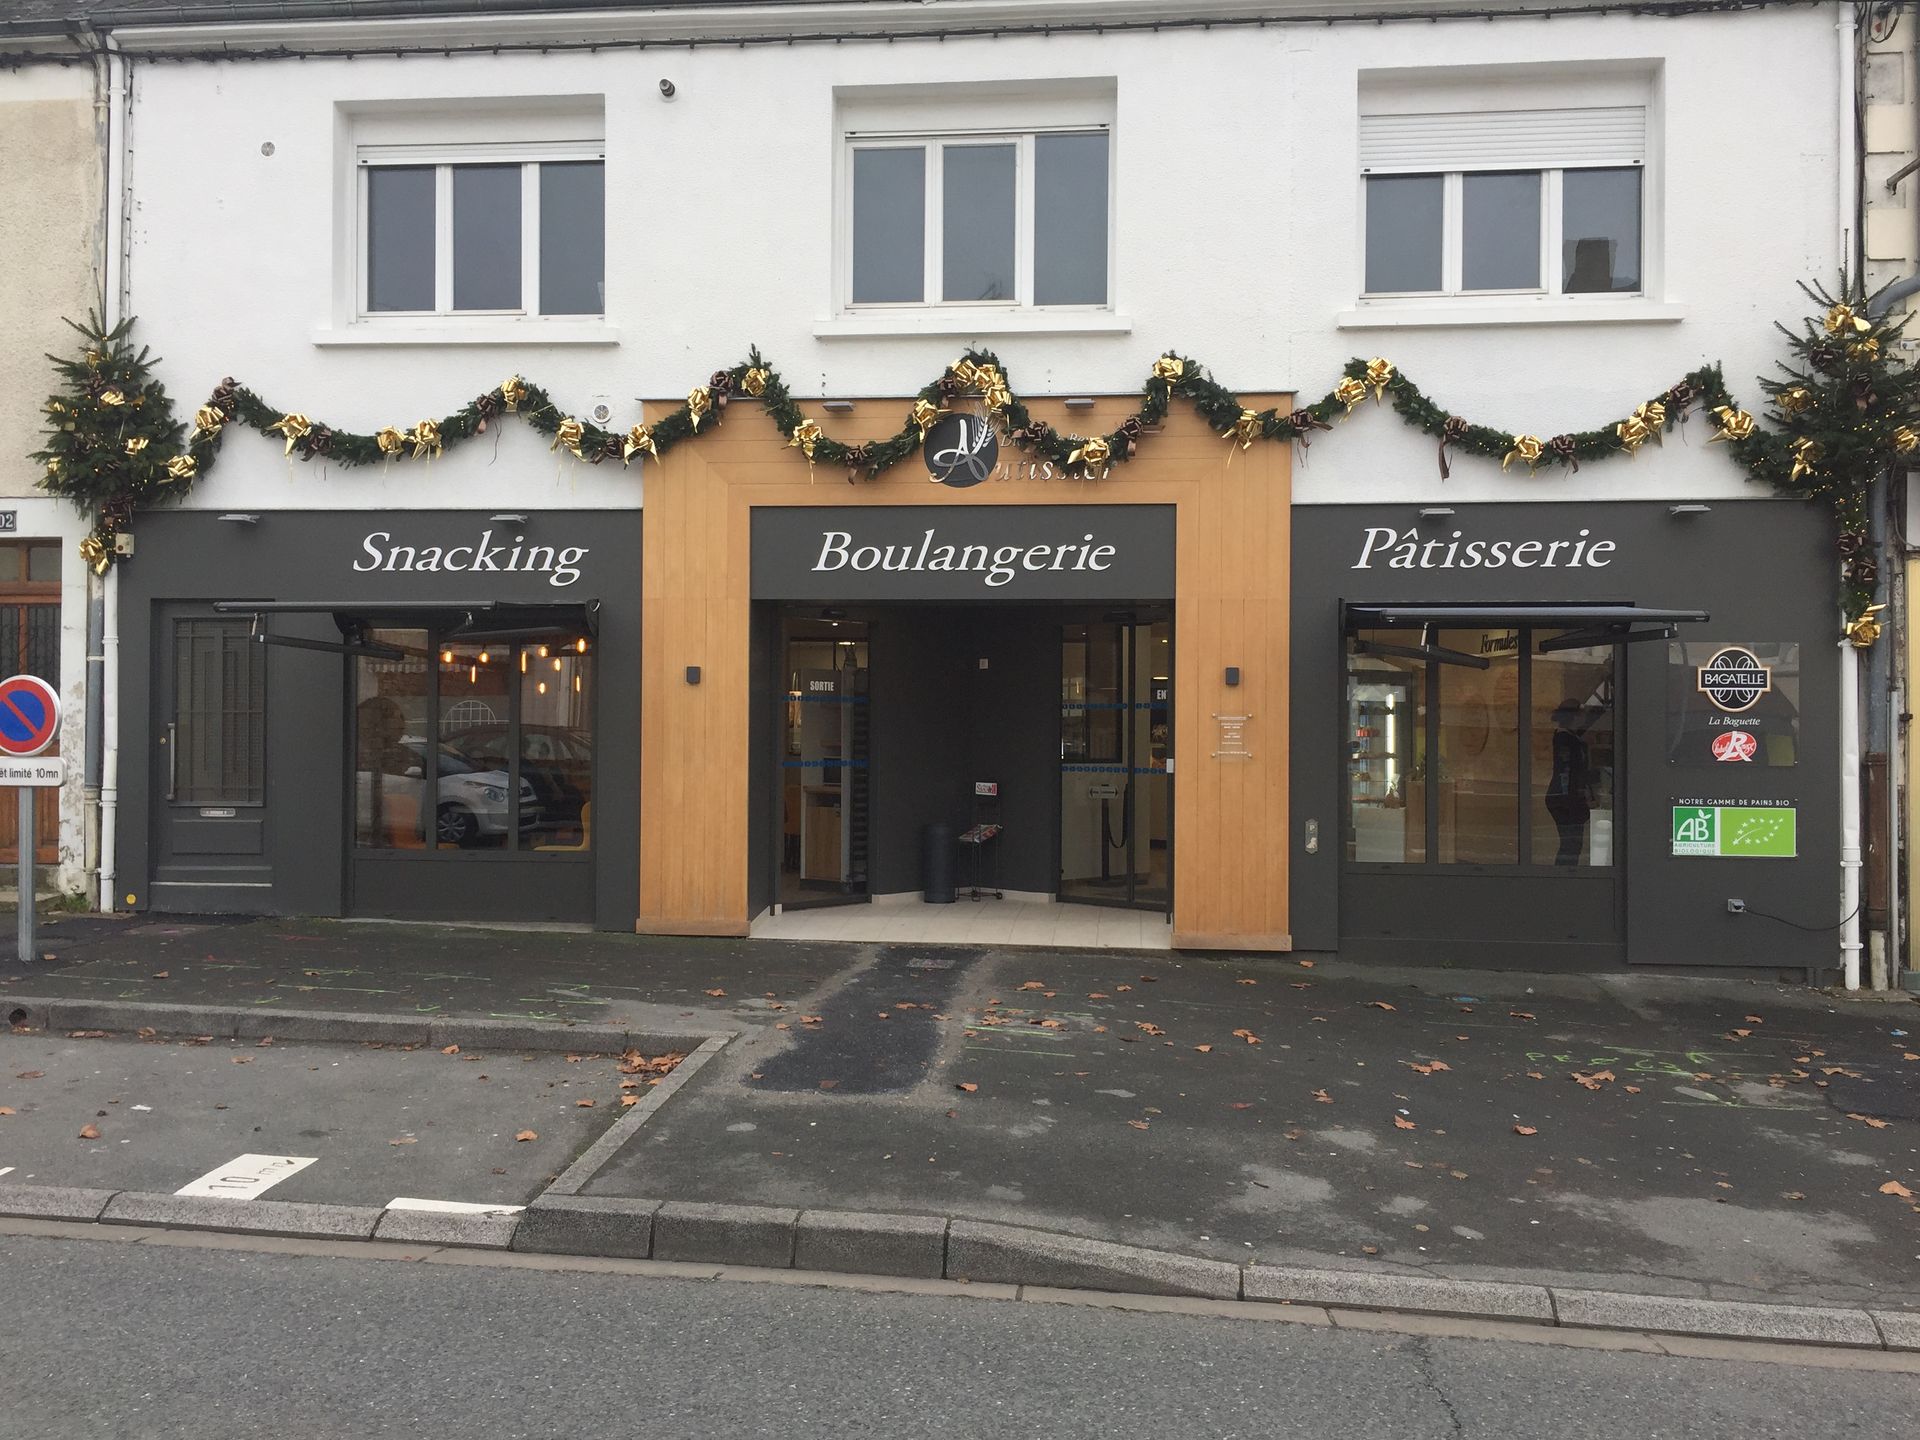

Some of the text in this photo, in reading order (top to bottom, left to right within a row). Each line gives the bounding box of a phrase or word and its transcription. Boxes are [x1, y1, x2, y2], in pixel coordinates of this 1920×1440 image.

[1351, 527, 1617, 569] Pâtisserie
[352, 530, 590, 587] Snacking
[811, 529, 1117, 587] Boulangerie
[1704, 673, 1765, 685] BAGATELLE
[809, 680, 835, 692] SORTIE
[1708, 716, 1761, 728] La Baguette
[9, 767, 32, 778] limité
[1706, 798, 1736, 806] GAMME
[1676, 818, 1710, 841] AB
